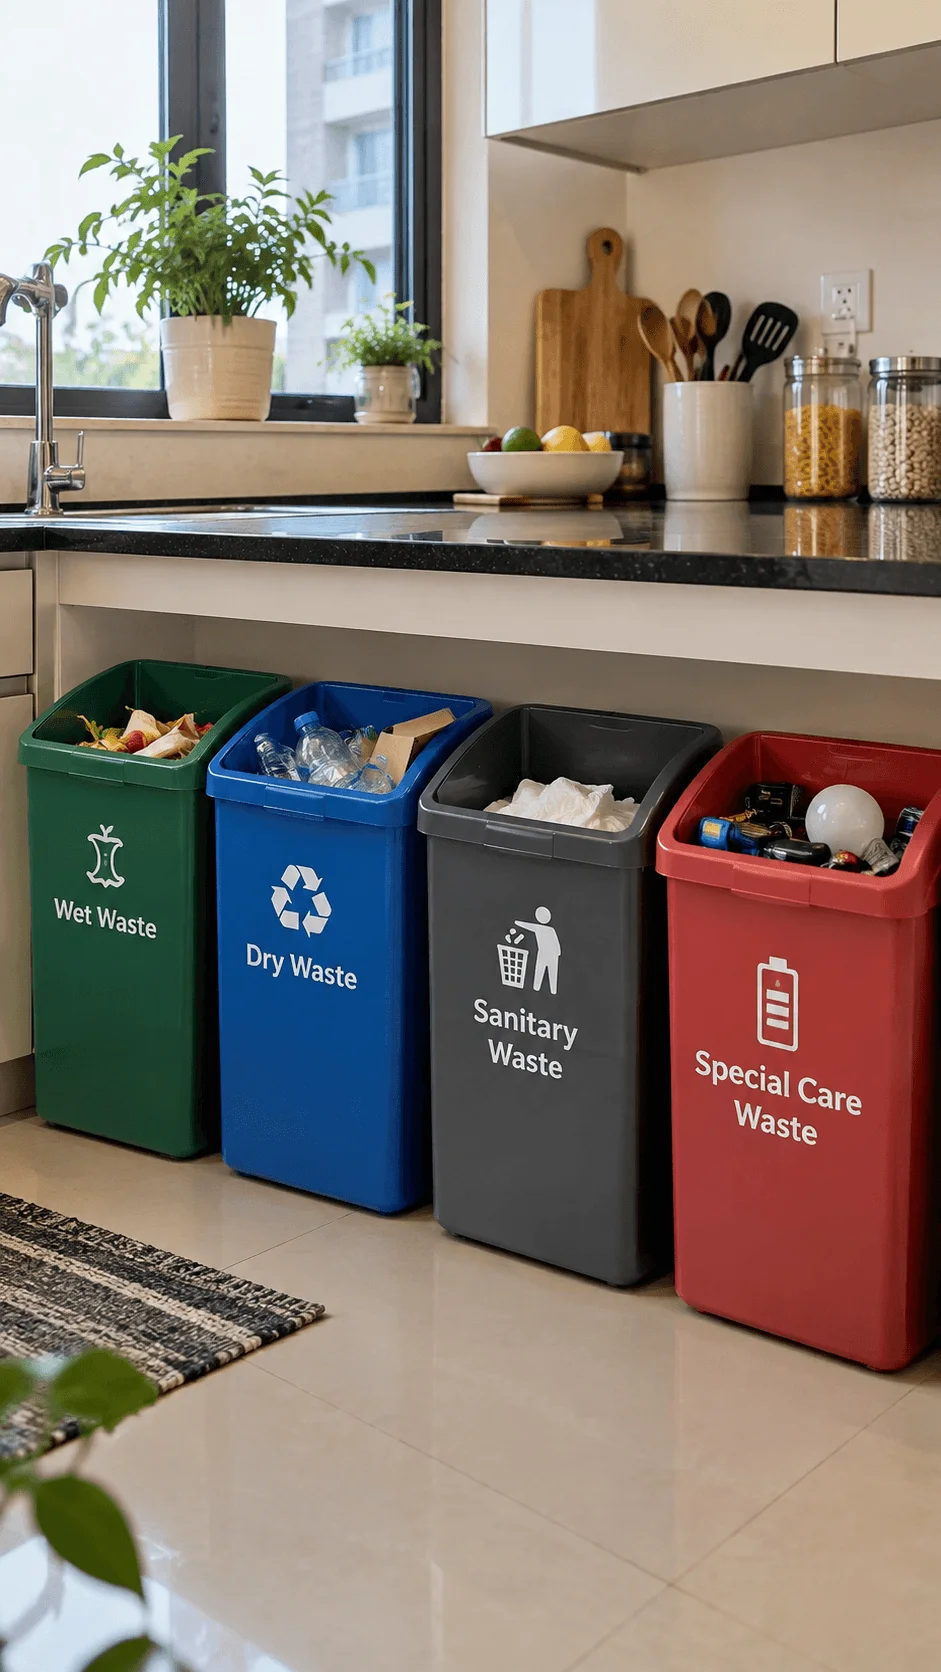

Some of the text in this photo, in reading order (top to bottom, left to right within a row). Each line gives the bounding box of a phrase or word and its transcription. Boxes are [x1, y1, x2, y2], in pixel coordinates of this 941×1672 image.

[53, 897, 157, 939] Wet Waste
[246, 943, 358, 990] Dry Waste
[473, 998, 579, 1051] Sanitary
[487, 1038, 563, 1079] Waste
[694, 1050, 863, 1116] Special Care
[733, 1099, 818, 1146] Waste
